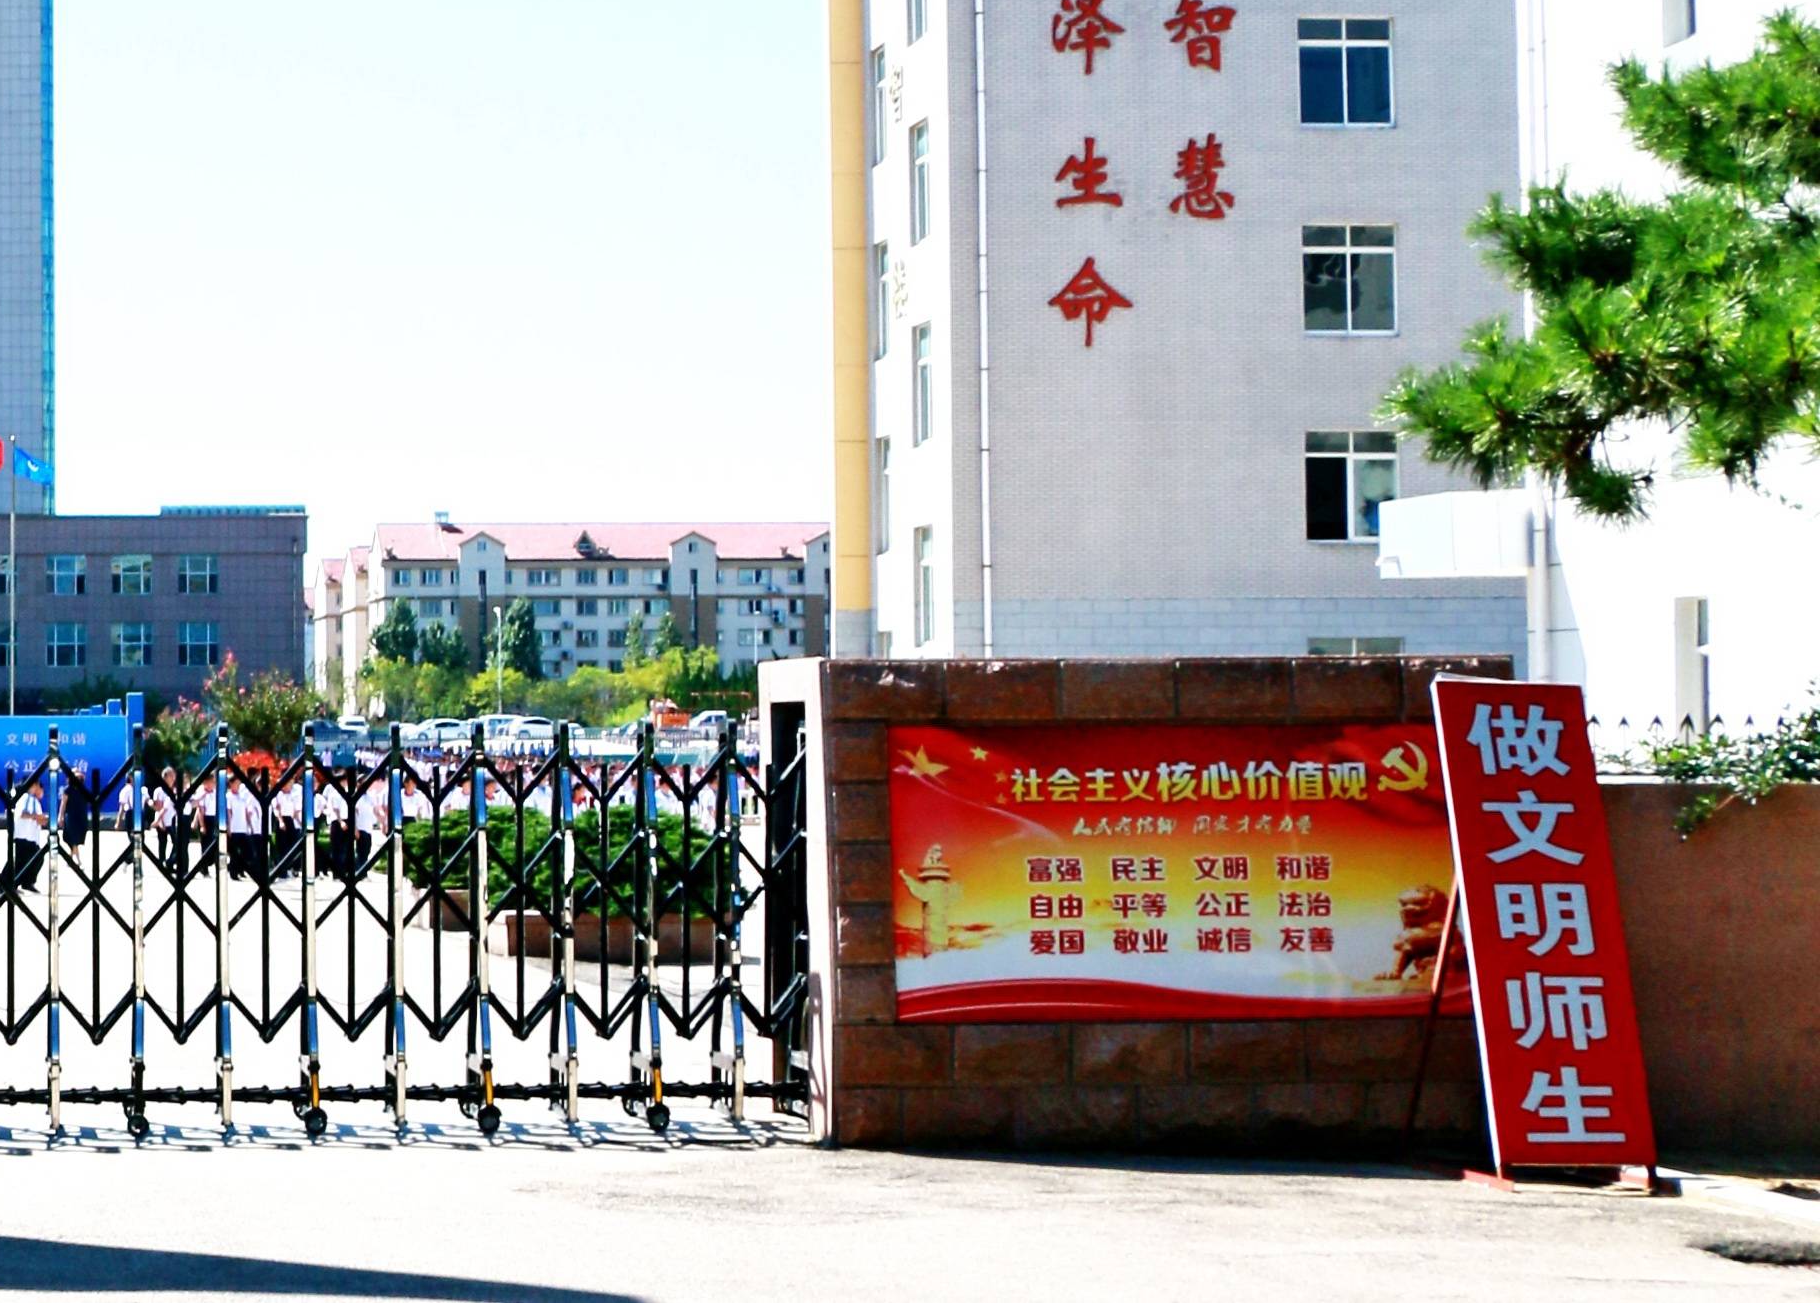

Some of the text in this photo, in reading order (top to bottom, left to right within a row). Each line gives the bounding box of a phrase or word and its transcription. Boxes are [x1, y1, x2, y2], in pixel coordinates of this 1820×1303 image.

[6, 732, 38, 746] 文明
[1010, 760, 1369, 802] 社会主义核心价值观
[1027, 855, 1332, 882] 富强 民主 文明 和谐
[1029, 892, 1333, 920] 自由 平等 公正 法治
[1466, 704, 1626, 1144] 做文明师生
[1029, 927, 1335, 955] 爱国 敬业 诚信 友善
